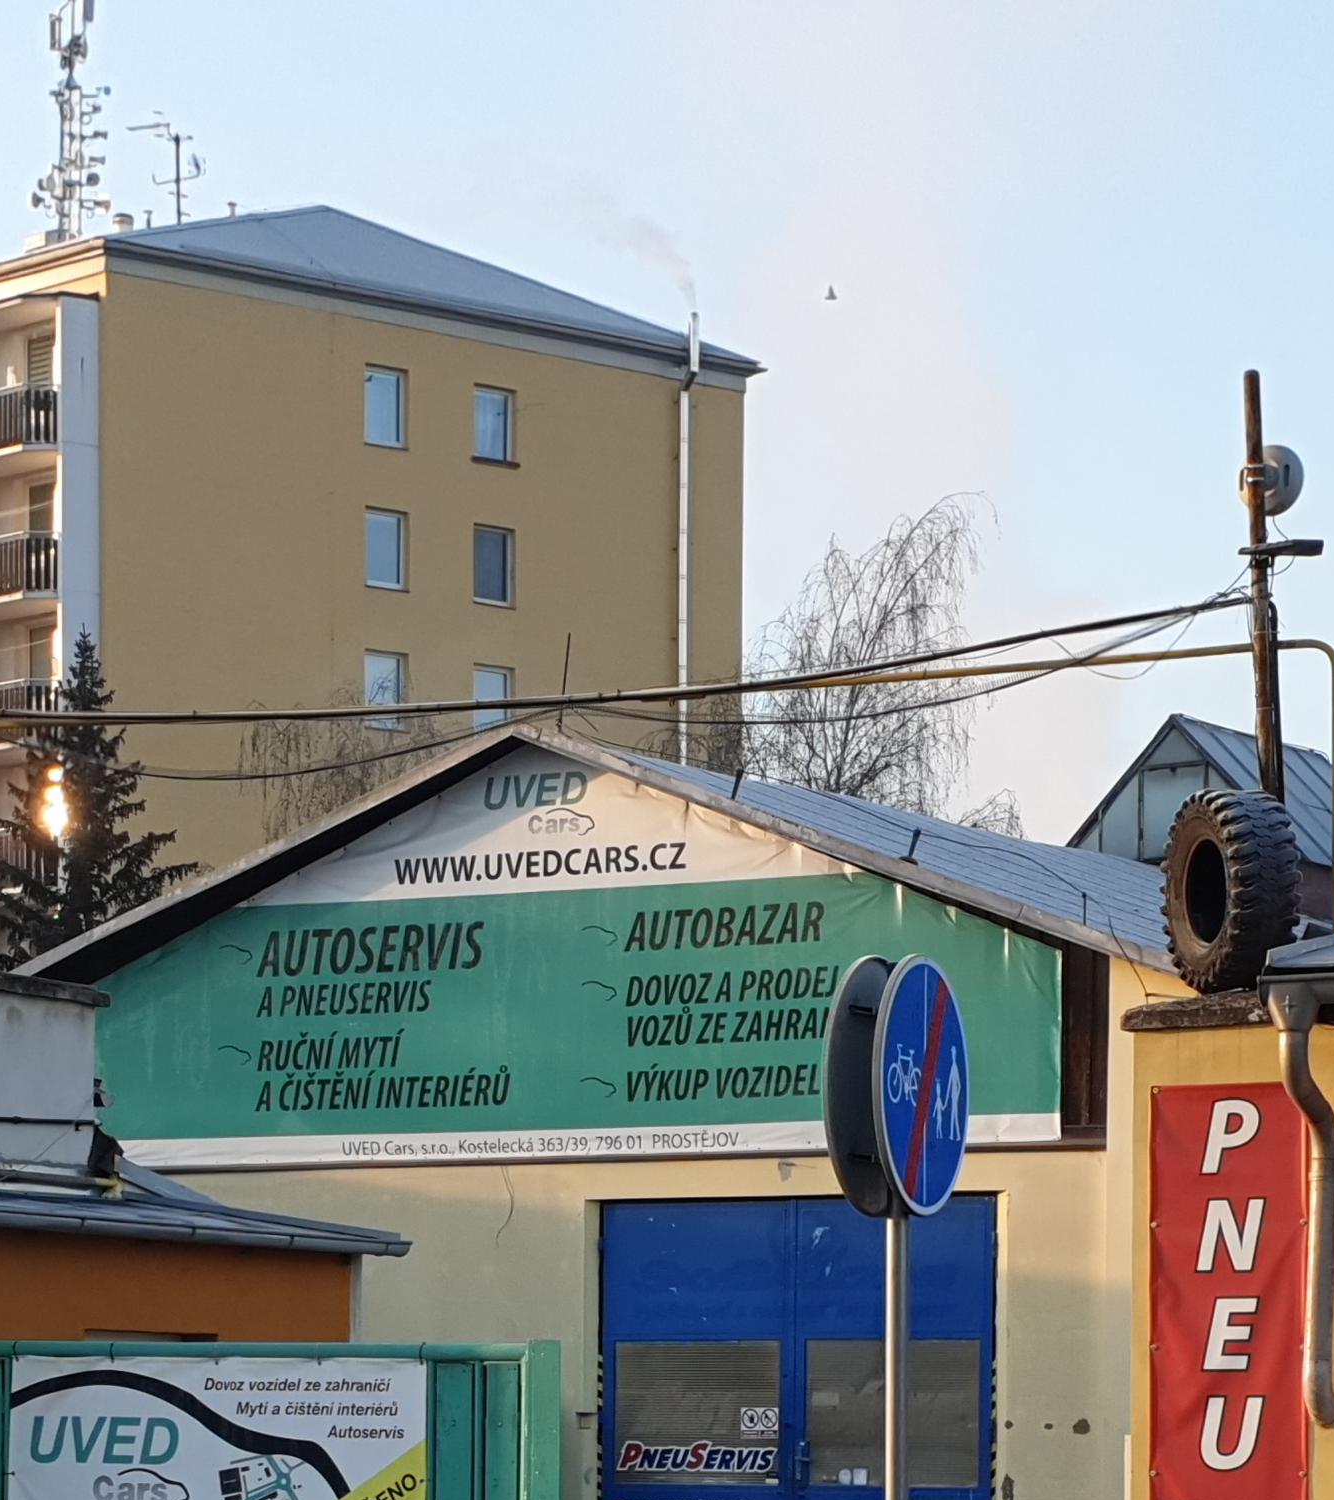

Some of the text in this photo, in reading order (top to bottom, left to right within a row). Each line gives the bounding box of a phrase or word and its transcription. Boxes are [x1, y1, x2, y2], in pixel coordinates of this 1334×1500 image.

[484, 771, 588, 810] UVED
[528, 814, 581, 835] Cars
[395, 842, 687, 885] WWW.UVEDCARS.CZ
[624, 901, 825, 953] AUTOBAZAR
[256, 921, 485, 978] AUTOSERVIS
[256, 980, 432, 1018] A PNEUSERVIS
[626, 965, 840, 1007] DOVOZ A PRODEJ
[627, 1006, 693, 1047] VOZŮ
[696, 1012, 728, 1045] ZE
[257, 1028, 405, 1071] RUČNÍ MYTÍ
[255, 1065, 511, 1112] A ČIŠTĚNÍ INTERIÉRŮ
[626, 1063, 821, 1102] VÝKUP VOZIDEL
[342, 1140, 381, 1157] UVED
[384, 1139, 418, 1158] Cars,
[458, 1136, 534, 1154] Kostelecká
[538, 1135, 592, 1154] 363/39,
[595, 1135, 623, 1151] 796
[626, 1135, 643, 1151] 01
[652, 1129, 739, 1150] PROSTĚJOV
[1194, 1098, 1266, 1472] PNEU
[204, 1378, 392, 1393] Dovoz vozidel ze zahraničí
[236, 1401, 398, 1417] Mytí a čištění interiérů
[29, 1416, 180, 1465] UVED
[328, 1425, 405, 1439] Autoservis
